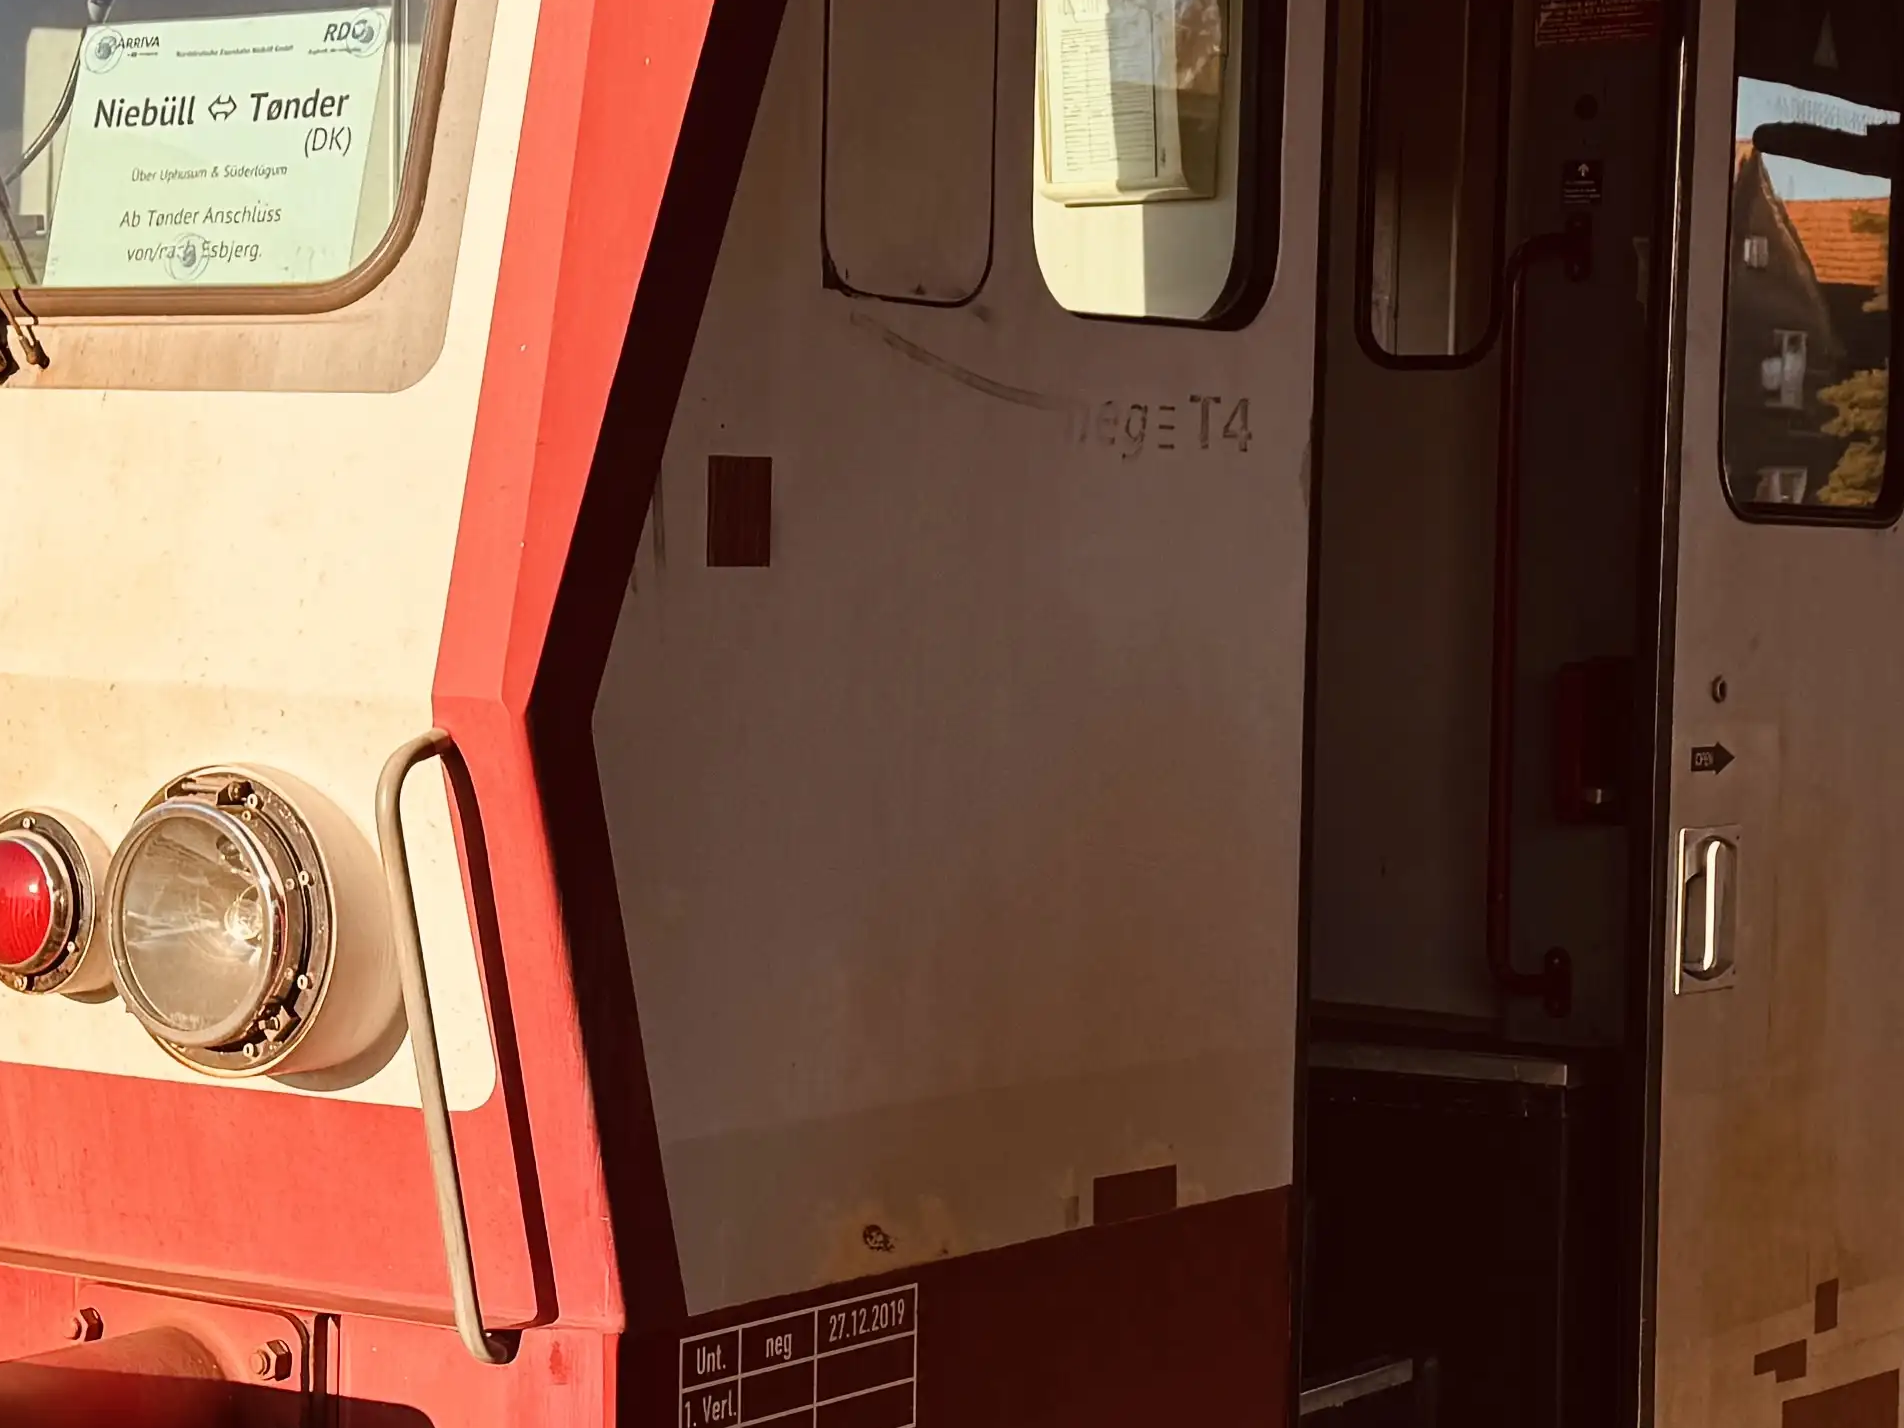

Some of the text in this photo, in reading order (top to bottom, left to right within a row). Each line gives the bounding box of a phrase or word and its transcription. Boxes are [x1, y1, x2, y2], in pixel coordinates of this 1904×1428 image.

[116, 35, 161, 49] ARRIVA
[93, 88, 350, 129] Niebüll Tønder
[304, 127, 353, 157] (DK)
[131, 164, 289, 184] Über Uphusum & Süderlügum
[119, 210, 141, 228] Ab
[147, 207, 200, 228] Tønder
[201, 239, 263, 263] Esbjerg.
[1188, 393, 1254, 454] T4
[695, 1298, 906, 1375] Unt. neg 27.12.2019
[684, 1388, 737, 1428] 1. Verl.
